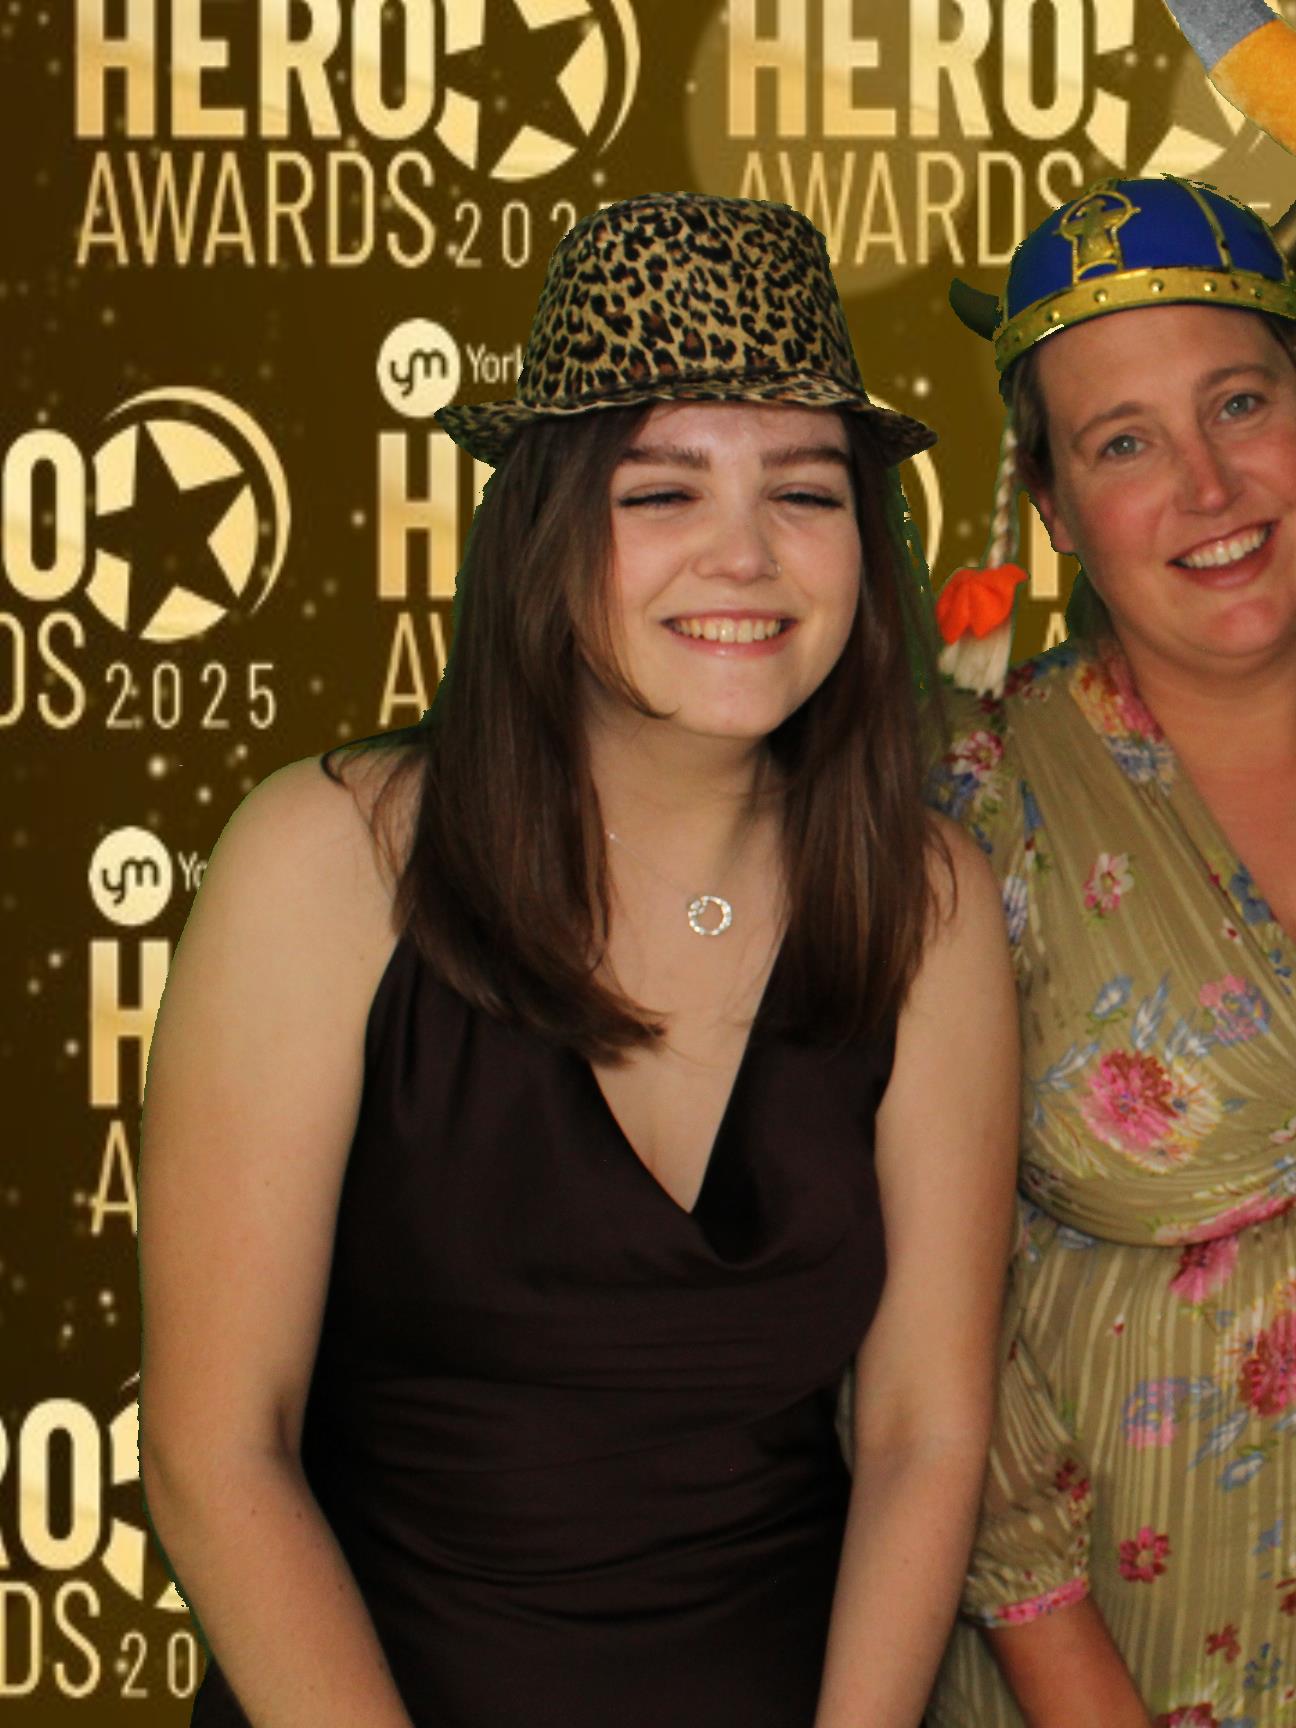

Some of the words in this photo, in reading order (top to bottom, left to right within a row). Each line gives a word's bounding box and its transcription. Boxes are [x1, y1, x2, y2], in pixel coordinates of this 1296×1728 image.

[75, 0, 436, 139] HERO
[727, 0, 1086, 139] HERO
[76, 150, 437, 268] AWARDS
[454, 202, 615, 269] 202
[390, 348, 448, 397] ym
[105, 661, 276, 730] 2025
[102, 856, 160, 907] ym
